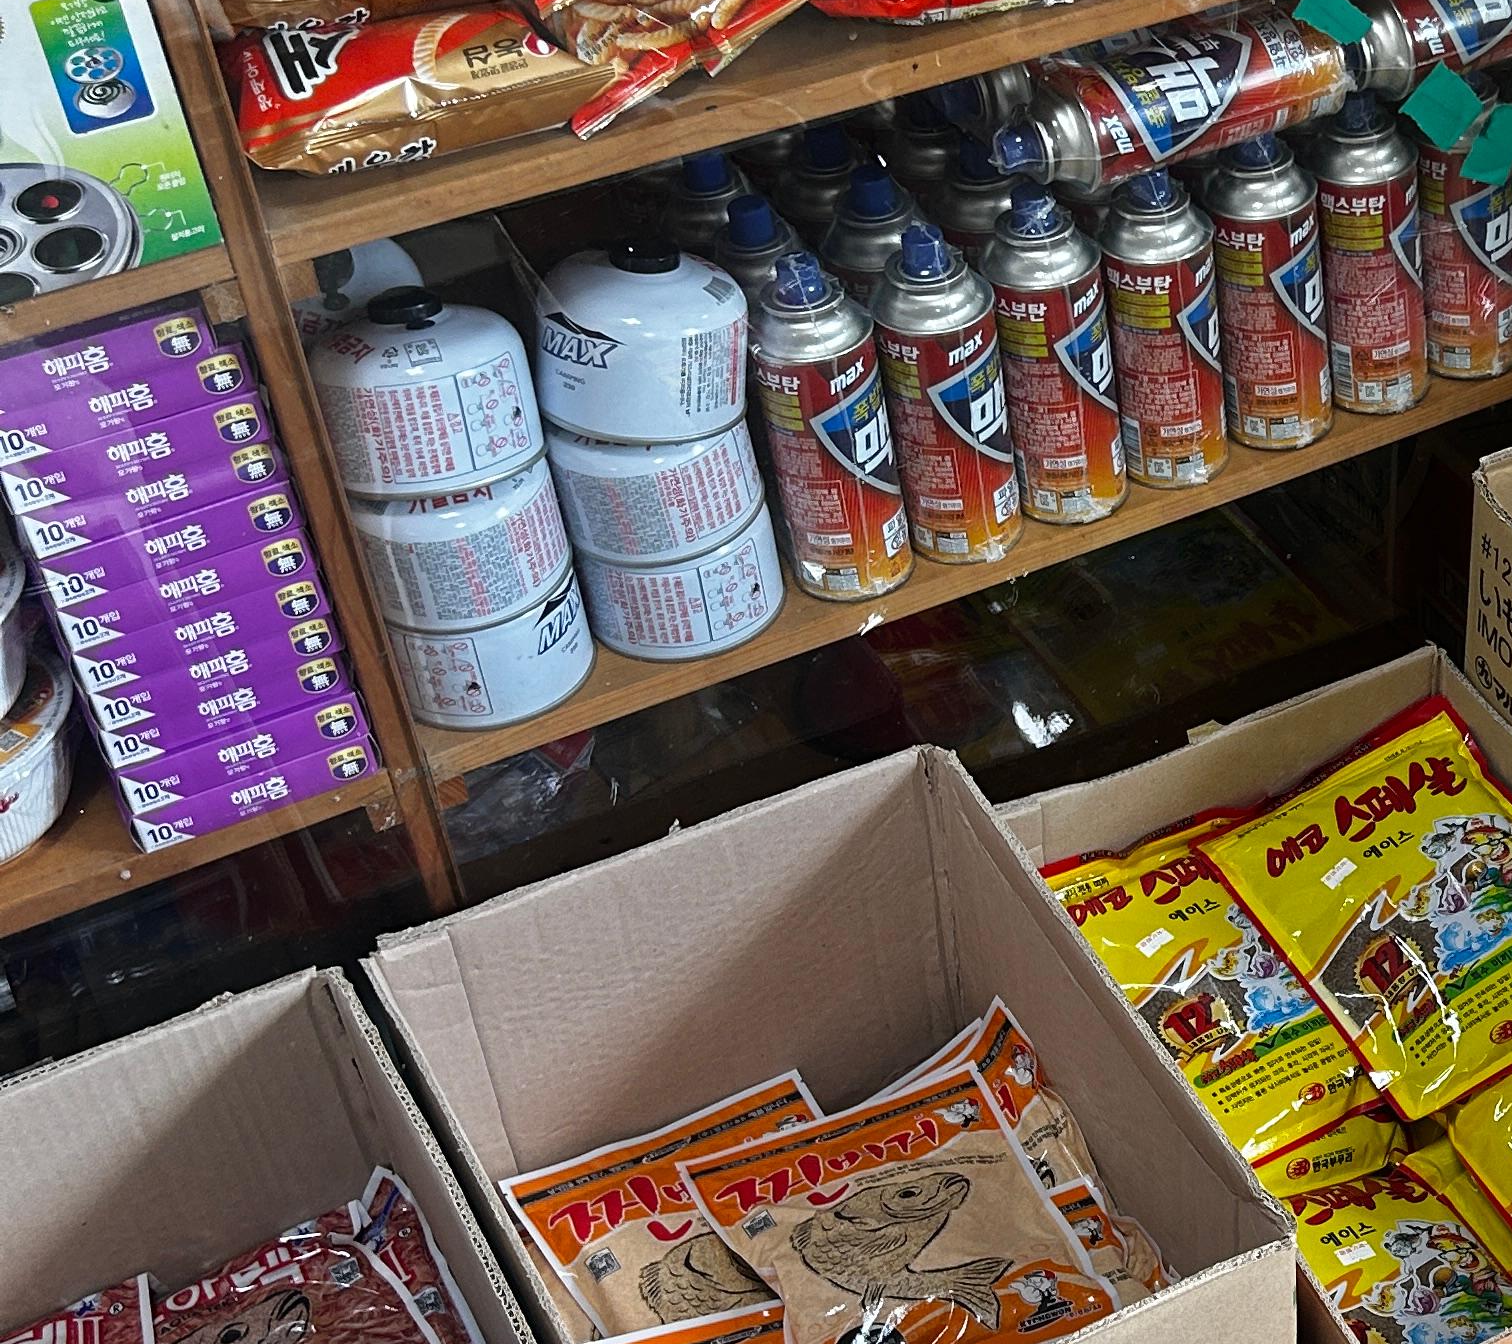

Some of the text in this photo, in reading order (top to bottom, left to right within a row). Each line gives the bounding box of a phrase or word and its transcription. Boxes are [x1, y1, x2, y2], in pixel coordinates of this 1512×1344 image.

[462, 37, 524, 67] 농심
[1102, 111, 1134, 156] max
[1320, 192, 1387, 217] 맥스부탄
[1106, 265, 1173, 295] 맥스부탄
[1073, 282, 1101, 319] max
[42, 345, 110, 377] 해피홈
[541, 324, 620, 370] MAX
[947, 329, 984, 368] max
[829, 356, 865, 397] max
[89, 383, 155, 414] 해피홈
[107, 433, 173, 463] 해피홈
[14, 478, 43, 501] 10
[126, 474, 190, 506] 해피홈
[36, 523, 65, 546] 10
[144, 525, 208, 555] 해피홈
[160, 569, 222, 601] 해피홈
[72, 617, 100, 638] 10
[175, 611, 236, 642] 해피홈
[189, 650, 250, 680] 해피홈
[103, 700, 131, 721] 10
[198, 687, 258, 717] 해피홈
[218, 734, 277, 764] 해피홈
[134, 782, 160, 803] 10
[231, 777, 288, 807] 해피홈
[147, 822, 173, 843] 10
[1361, 829, 1415, 860] 에이스
[1264, 823, 1330, 880] 에코
[1167, 897, 1221, 924] 에이스
[1162, 995, 1214, 1043] 12
[1319, 1222, 1375, 1248] 에이스
